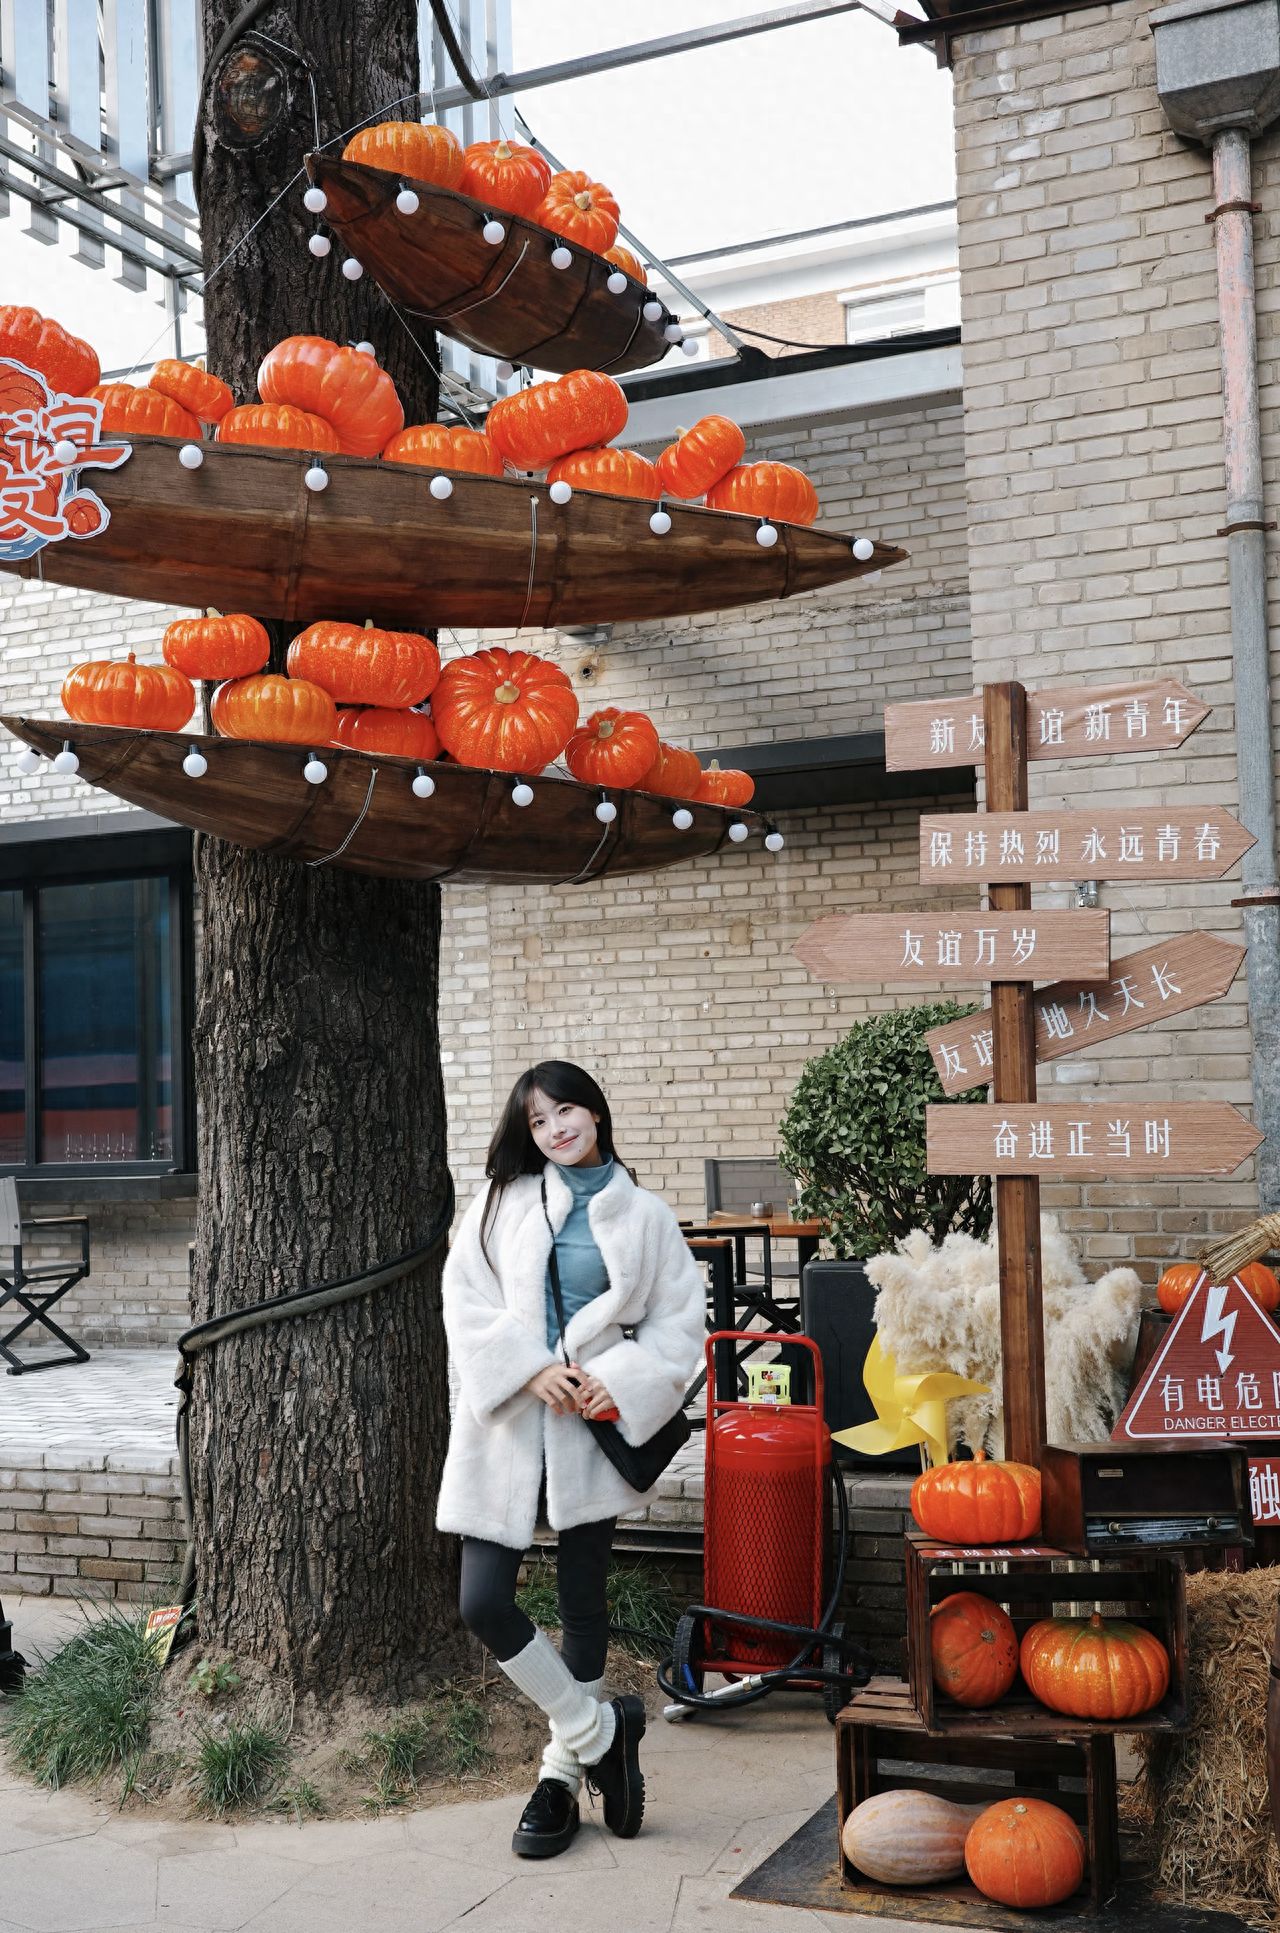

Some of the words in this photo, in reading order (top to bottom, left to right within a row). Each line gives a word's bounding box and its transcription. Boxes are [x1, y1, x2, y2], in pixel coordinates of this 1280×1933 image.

[899, 928, 1038, 967] 友谊万岁
[992, 1119, 1173, 1159] 奋进正当时
[1164, 1416, 1227, 1431] DANGER
